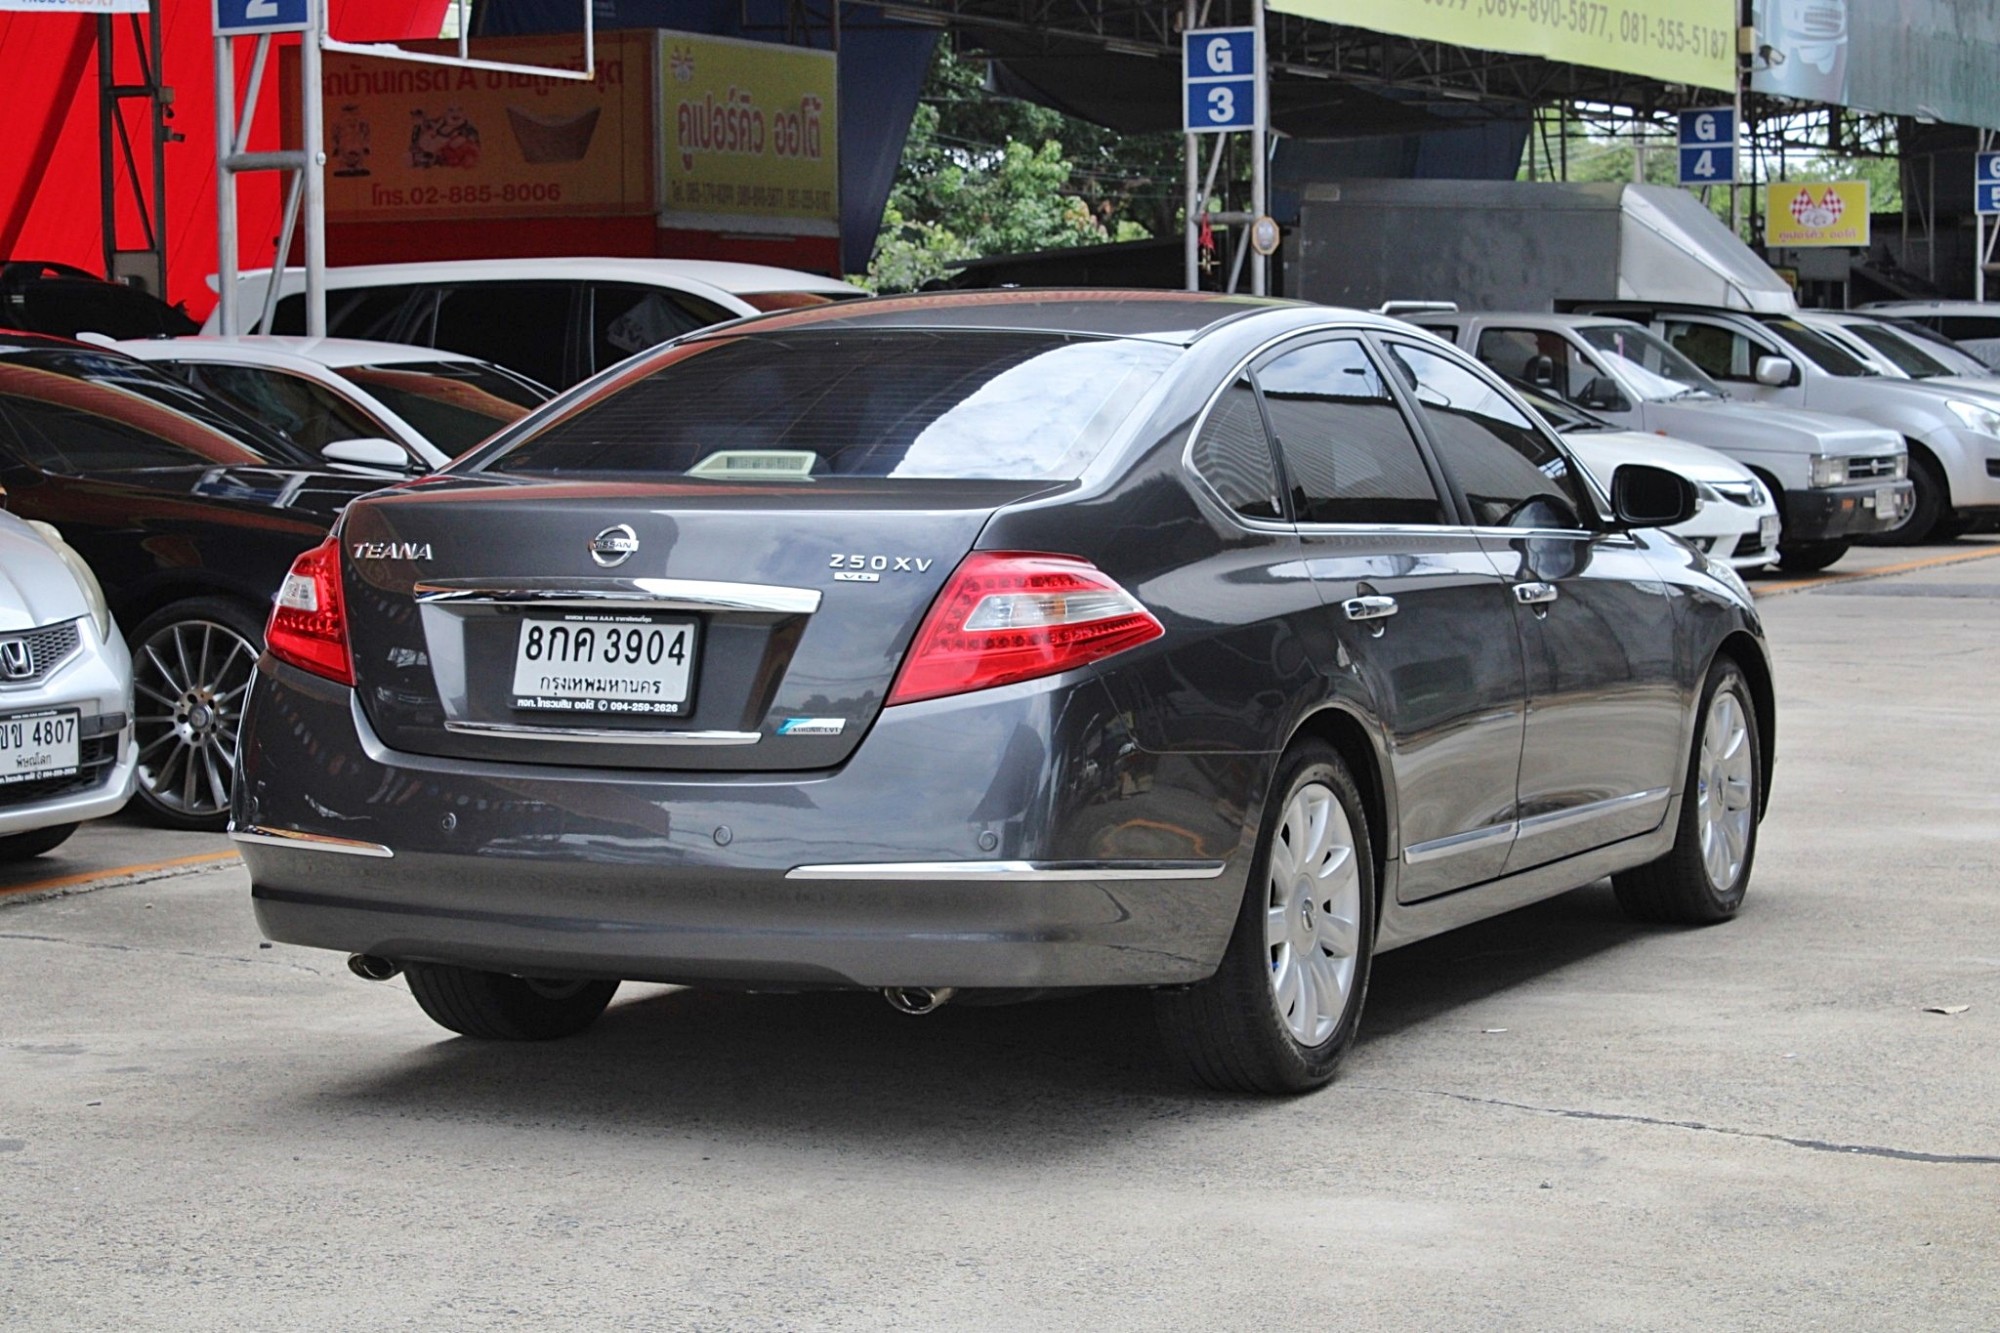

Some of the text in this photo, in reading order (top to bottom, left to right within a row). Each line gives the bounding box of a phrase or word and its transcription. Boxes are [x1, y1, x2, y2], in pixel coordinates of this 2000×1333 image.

[1620, 10, 1728, 61] 081-355-5187
[1206, 37, 1234, 73] G
[455, 66, 478, 91] A
[1207, 86, 1235, 123] 3
[1694, 113, 1716, 141] G
[1693, 149, 1716, 177] 4
[353, 542, 433, 561] TEANA
[595, 540, 632, 549] NISSAN
[525, 625, 685, 666] 8กค 3904
[540, 676, 662, 696] กรุงเทพมหานคร
[610, 702, 679, 713] 094-259-2626
[33, 718, 75, 747] 4807
